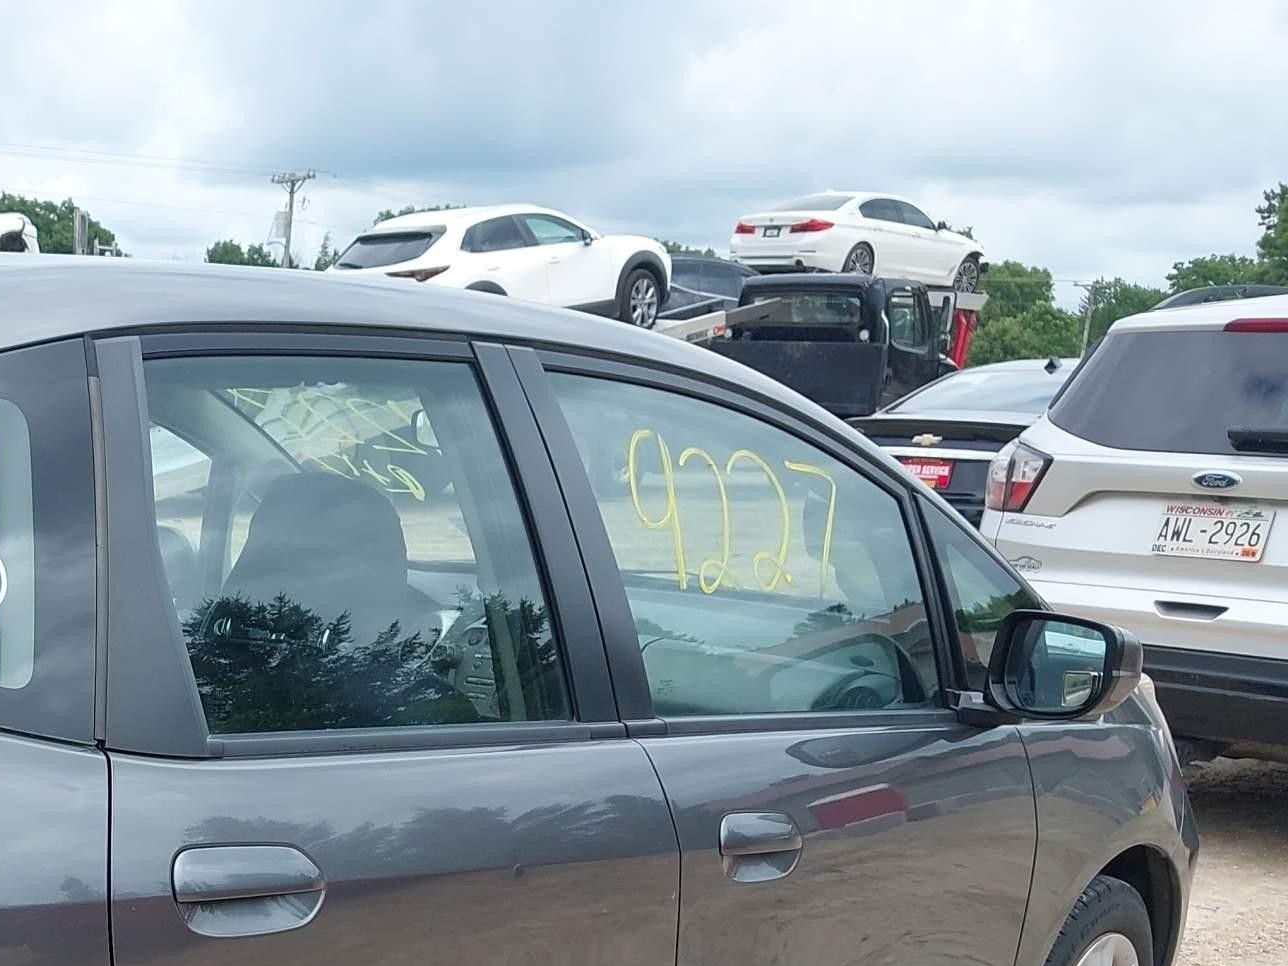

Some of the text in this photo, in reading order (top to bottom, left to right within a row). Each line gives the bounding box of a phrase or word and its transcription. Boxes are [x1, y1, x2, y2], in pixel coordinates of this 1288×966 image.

[1201, 473, 1230, 487] Ford
[628, 429, 837, 600] 9227
[1166, 504, 1225, 517] WISCONSIN
[1152, 543, 1167, 553] DEC
